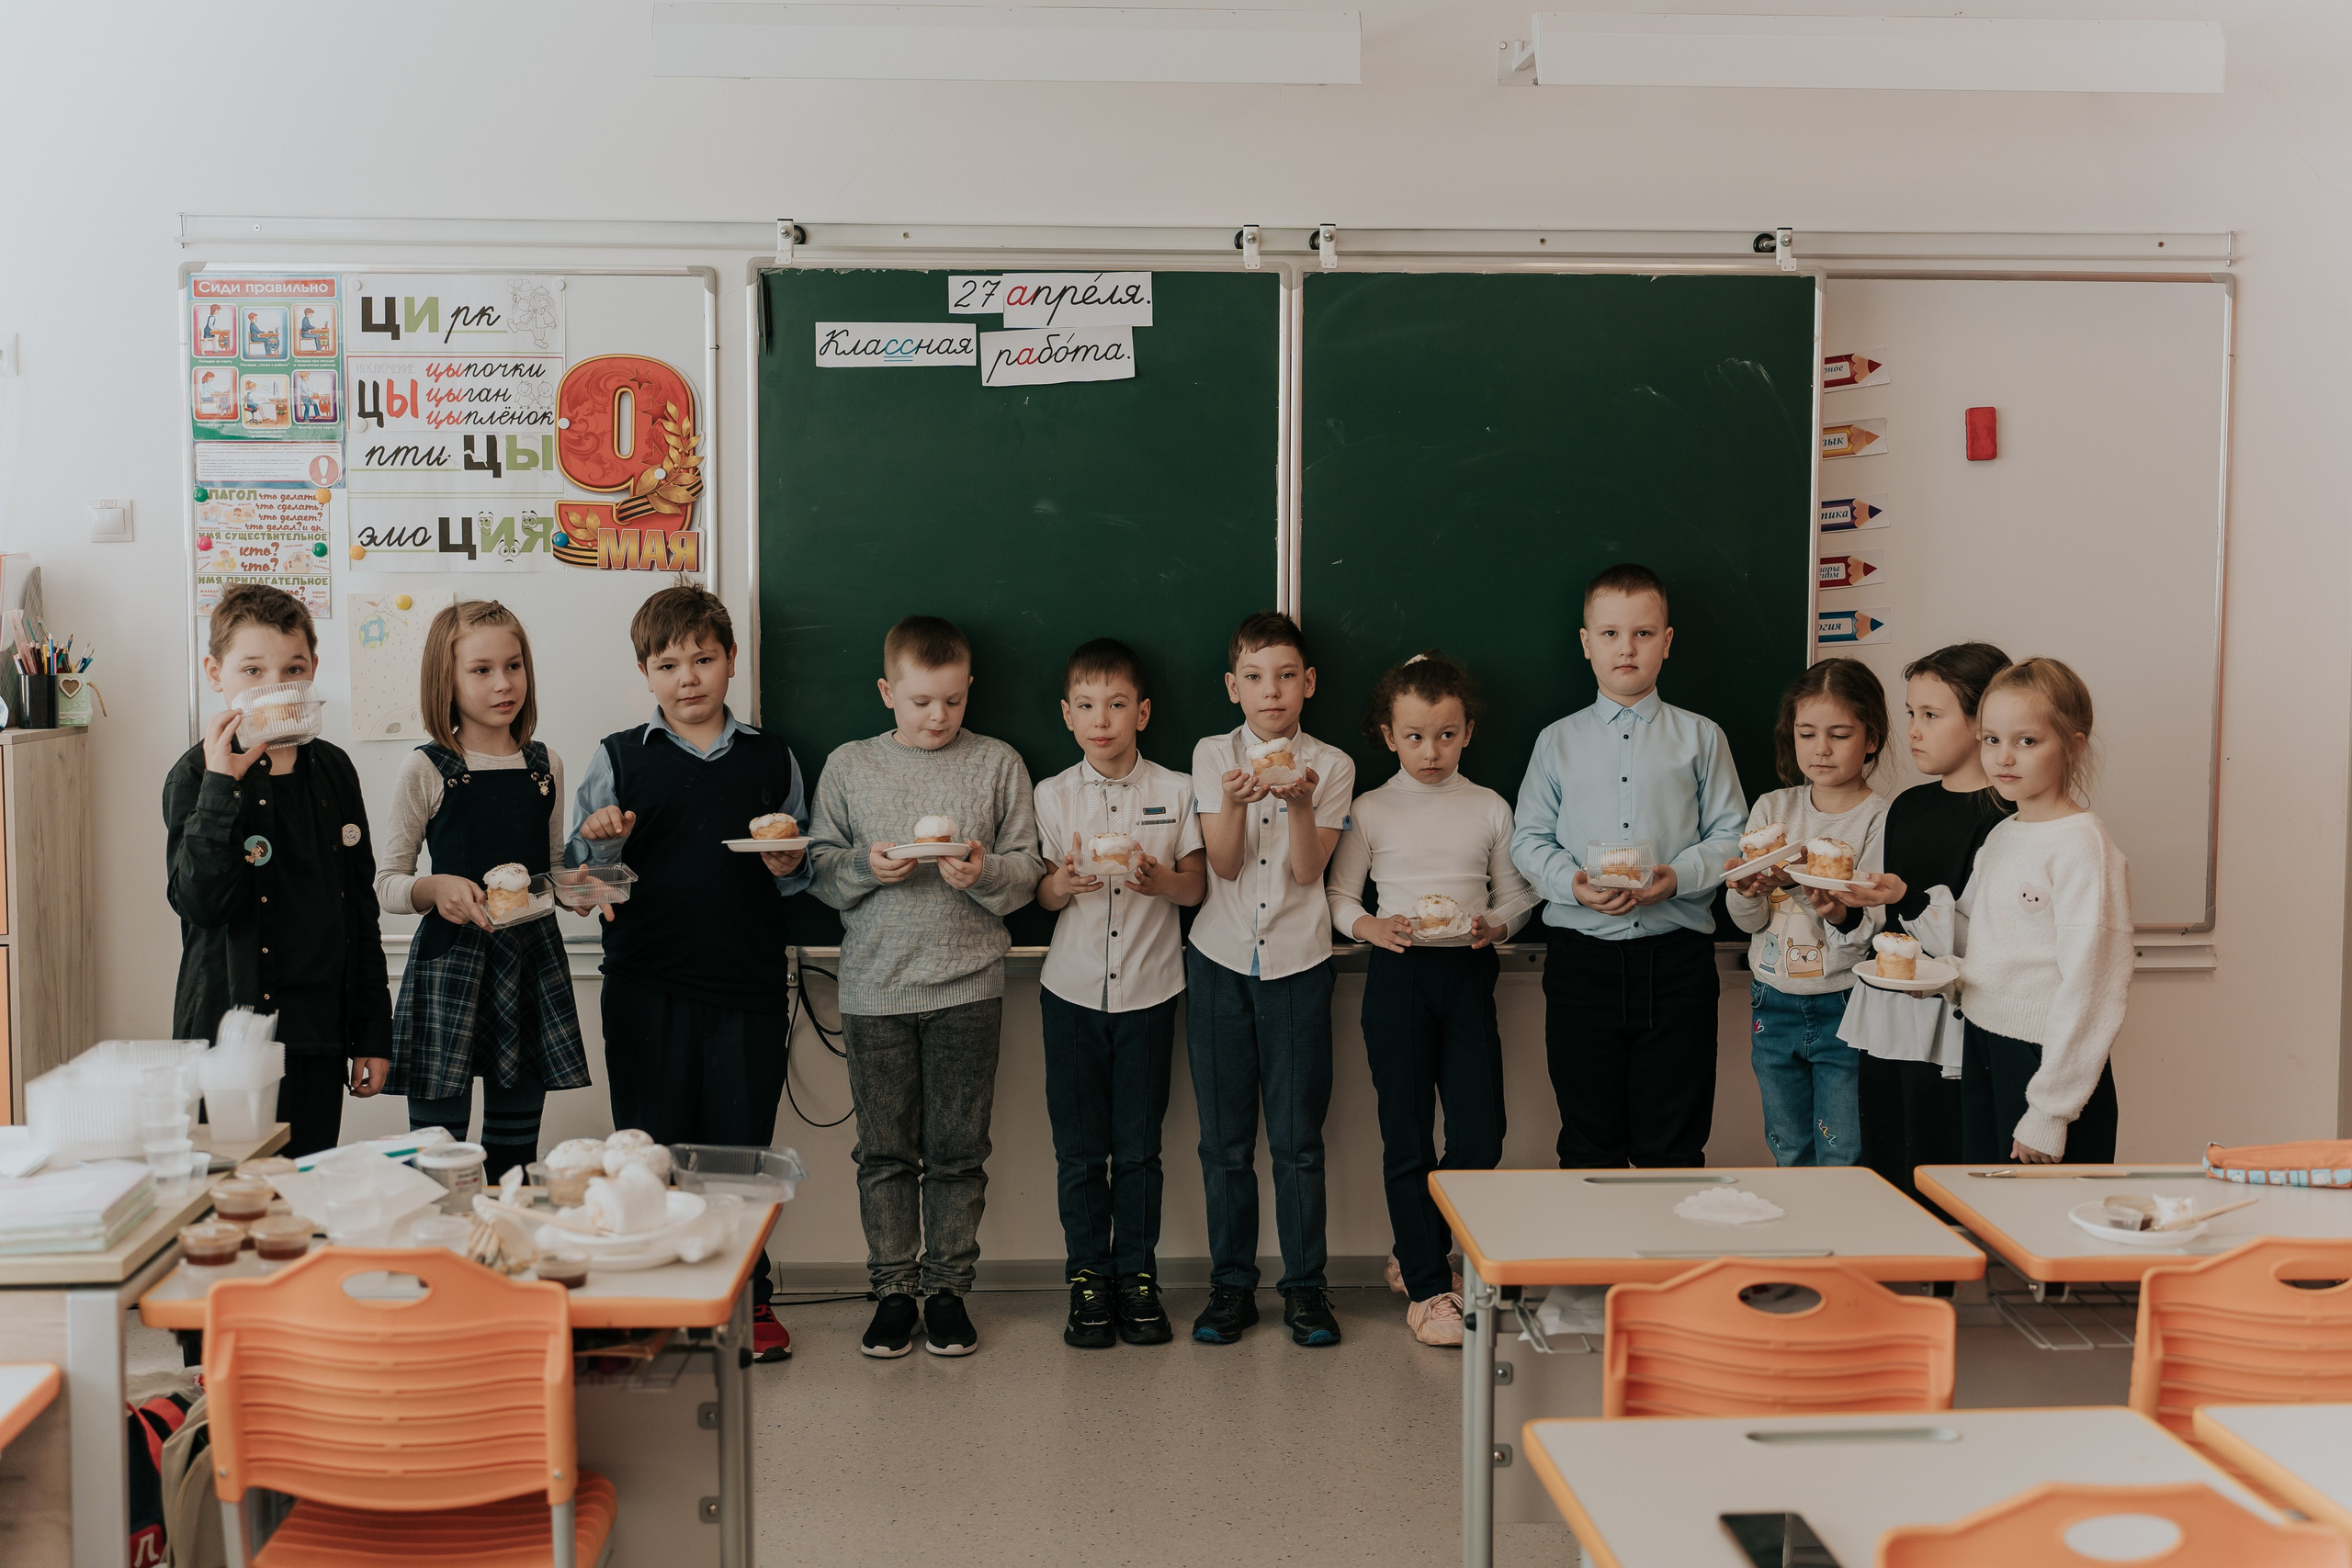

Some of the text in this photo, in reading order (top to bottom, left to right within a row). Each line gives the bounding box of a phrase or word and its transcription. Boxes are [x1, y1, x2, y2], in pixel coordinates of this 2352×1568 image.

[198, 281, 329, 296] Сиди правильно
[954, 280, 1001, 308] 27
[819, 329, 975, 356] Классная
[356, 363, 415, 375] ИСКЛЮЧЕНИЕ
[425, 362, 546, 384] цыпочки
[357, 378, 420, 429] ЦЫ
[425, 387, 513, 408] цыган
[425, 406, 555, 430] цыплёнок
[555, 354, 695, 549] 9
[208, 489, 258, 502] ЛАГОЛ
[258, 492, 277, 501] что
[279, 512, 323, 524] делает?
[266, 521, 302, 532] делал?
[224, 532, 328, 541] СУЩЕСТВИТЕЛЬНОЕ
[239, 541, 280, 557] кто?
[597, 527, 700, 572] МАЯ
[241, 557, 279, 572] что?
[198, 576, 328, 586] ИМЯ ПРИЛАГАТЕЛЬНОЕ
